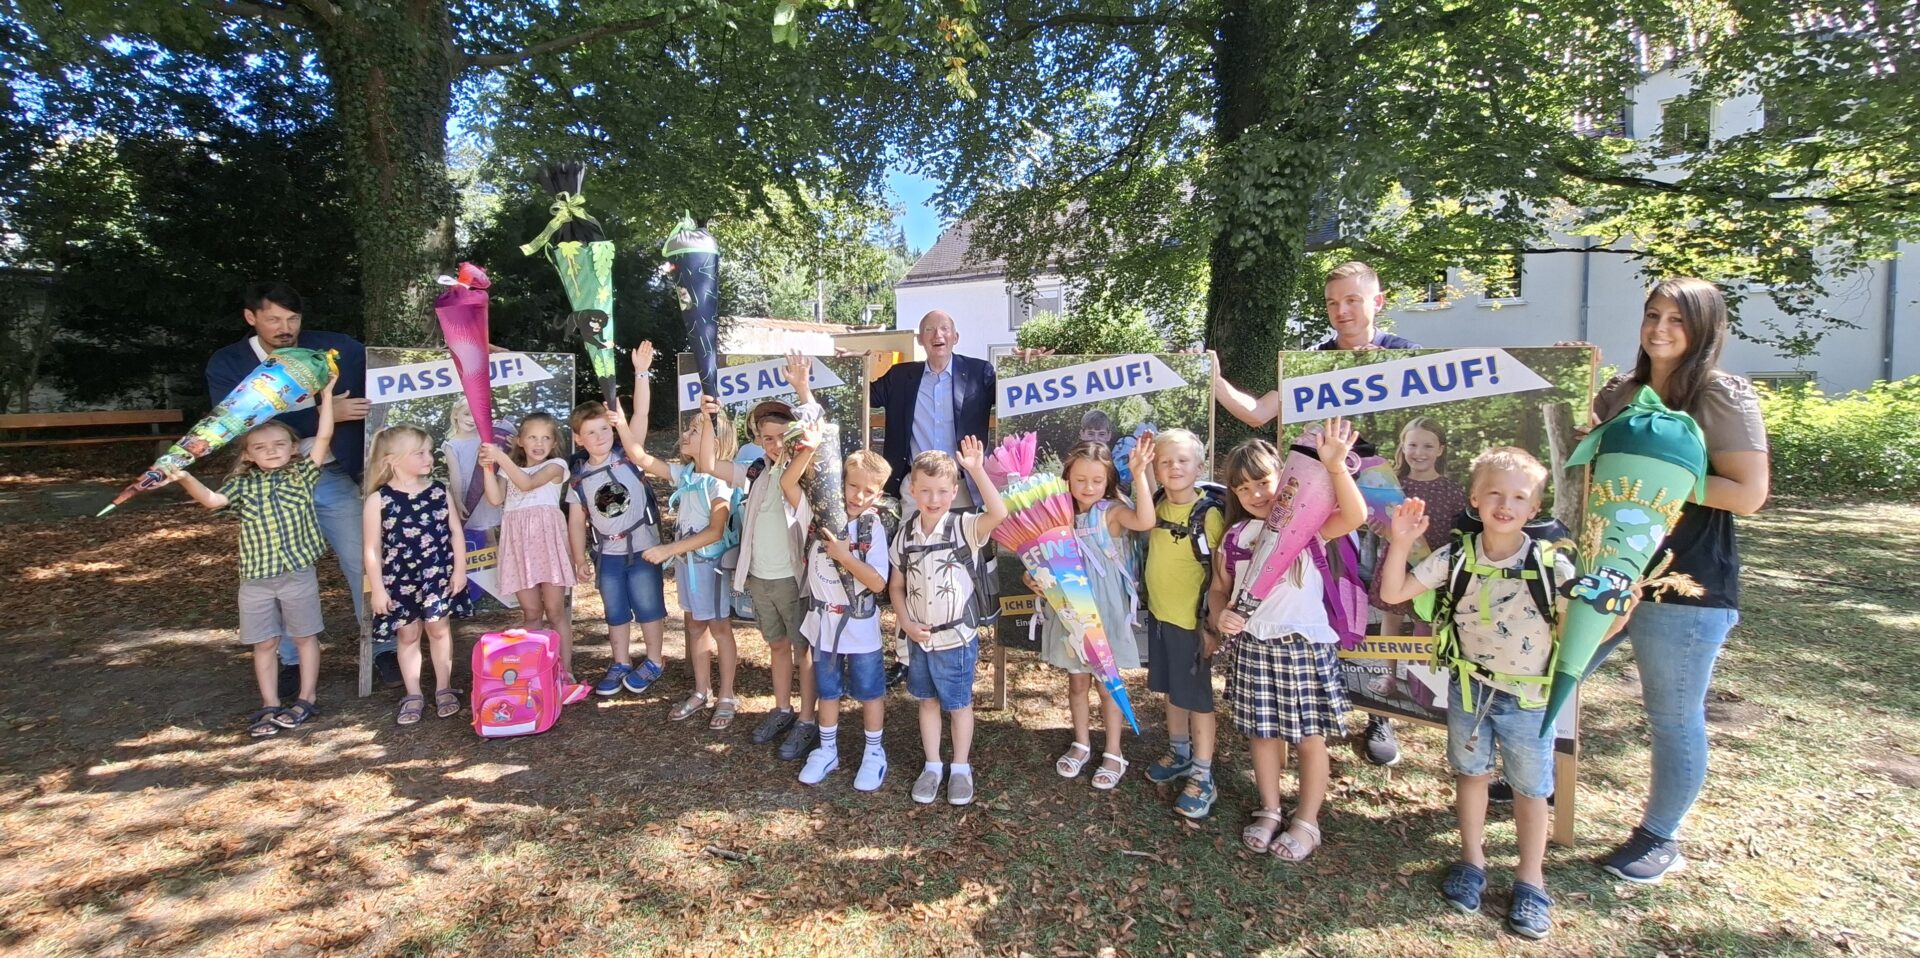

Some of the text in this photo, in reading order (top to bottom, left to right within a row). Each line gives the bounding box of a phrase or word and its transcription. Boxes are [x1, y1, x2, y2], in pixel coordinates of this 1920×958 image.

[377, 367, 452, 396] PASS
[687, 360, 815, 402] PSS AU!
[1006, 361, 1153, 408] PASS AUF!
[1293, 355, 1499, 413] PASS AUF!
[1005, 601, 1024, 611] ICH
[1367, 665, 1393, 675] von:
